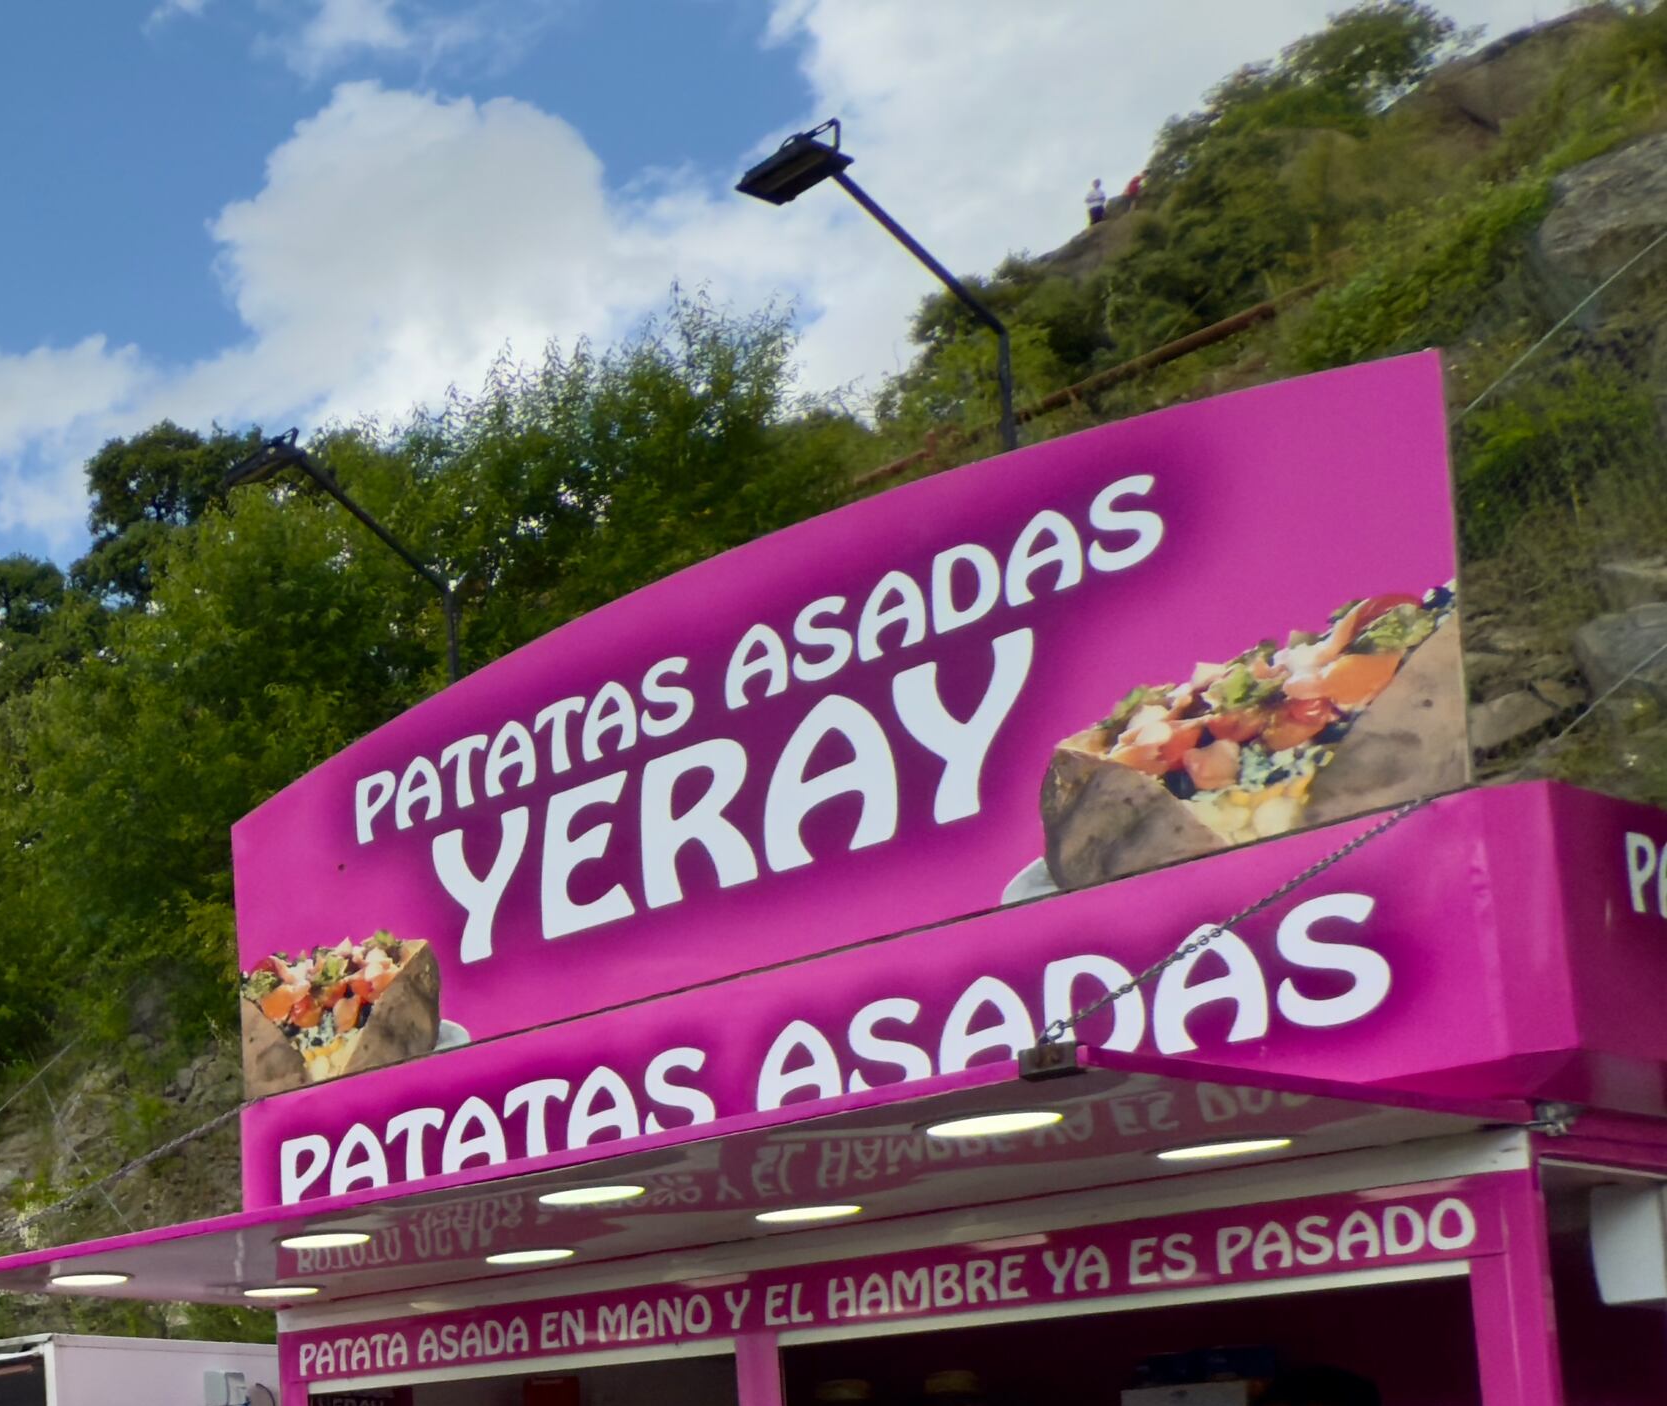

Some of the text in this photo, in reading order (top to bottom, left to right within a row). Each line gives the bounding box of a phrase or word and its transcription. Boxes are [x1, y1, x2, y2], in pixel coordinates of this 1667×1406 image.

[355, 474, 1165, 845] PATATAS ASADAS
[432, 627, 1034, 965] YERAY
[1625, 830, 1667, 919] P
[280, 892, 1392, 1205] PATATAS ASADAS
[299, 1198, 1476, 1378] PATATA ASADA EN MANO Y EL HAMBRE YA ES PASADO
